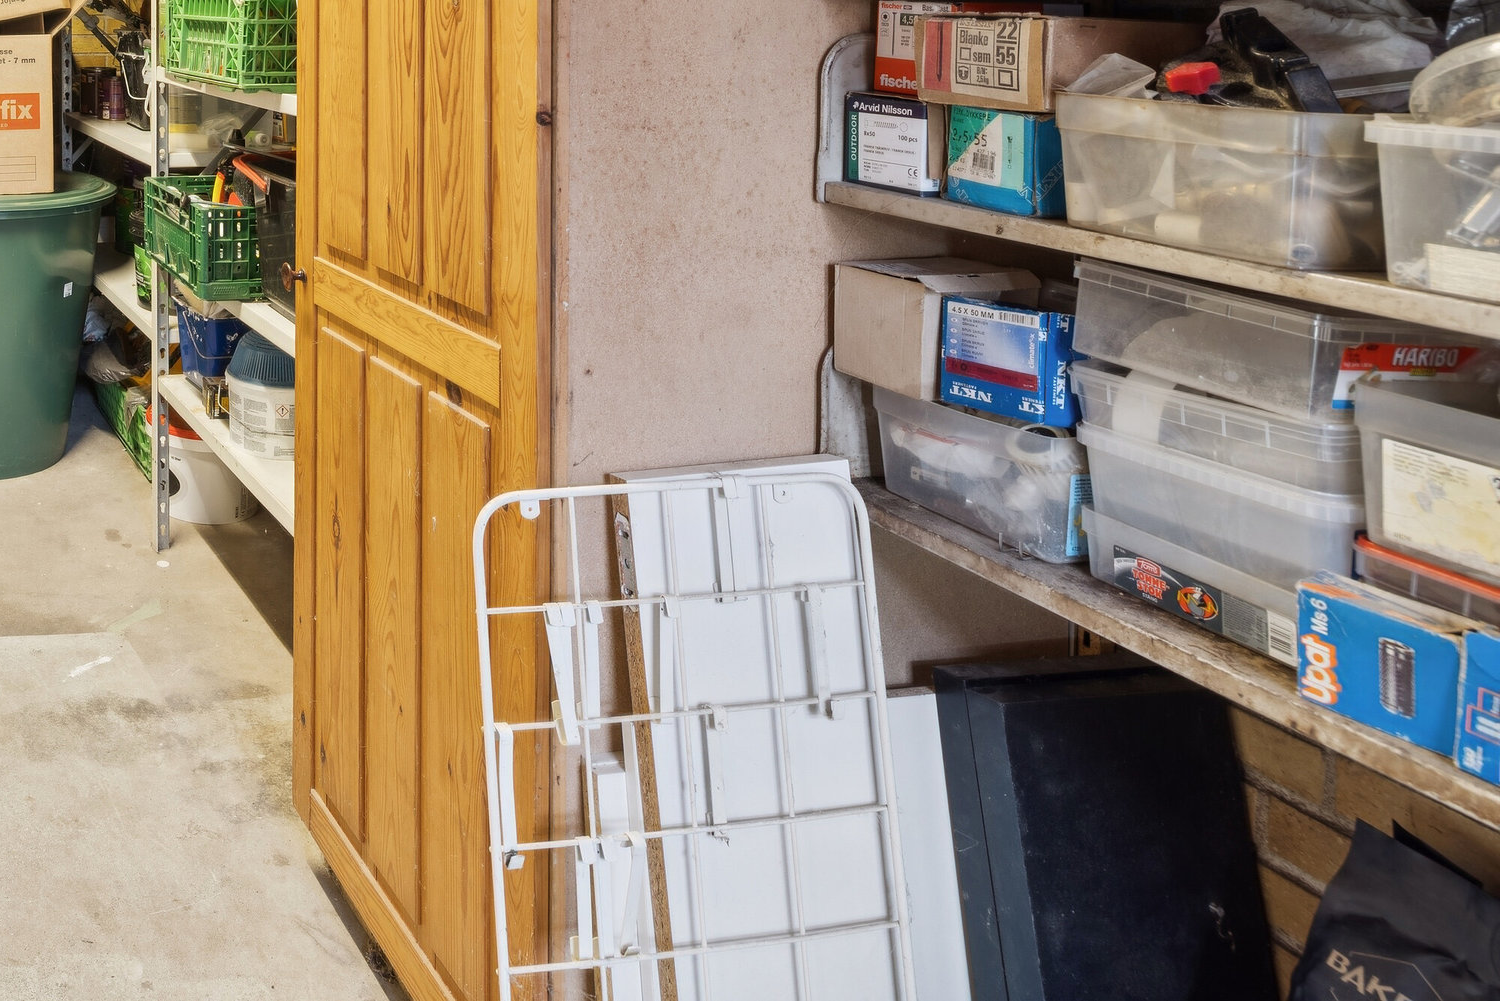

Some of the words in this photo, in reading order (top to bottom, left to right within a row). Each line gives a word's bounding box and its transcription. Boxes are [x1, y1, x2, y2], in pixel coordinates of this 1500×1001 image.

[960, 30, 989, 46] Blanke
[996, 21, 1018, 40] 22
[972, 52, 991, 64] søm
[995, 46, 1016, 66] 55
[0, 99, 33, 120] fix
[859, 102, 880, 112] Arvid
[881, 104, 913, 116] Nilsson
[952, 306, 962, 314] 4.5
[971, 309, 979, 317] 50
[980, 311, 994, 320] MM
[1392, 347, 1458, 367] HARIBO
[950, 385, 992, 404] NKT
[1056, 360, 1066, 410] NKT
[1137, 580, 1163, 600] STOK
[1310, 597, 1328, 610] 6
[1310, 610, 1329, 636] Ms
[1325, 949, 1412, 1001] BAK
